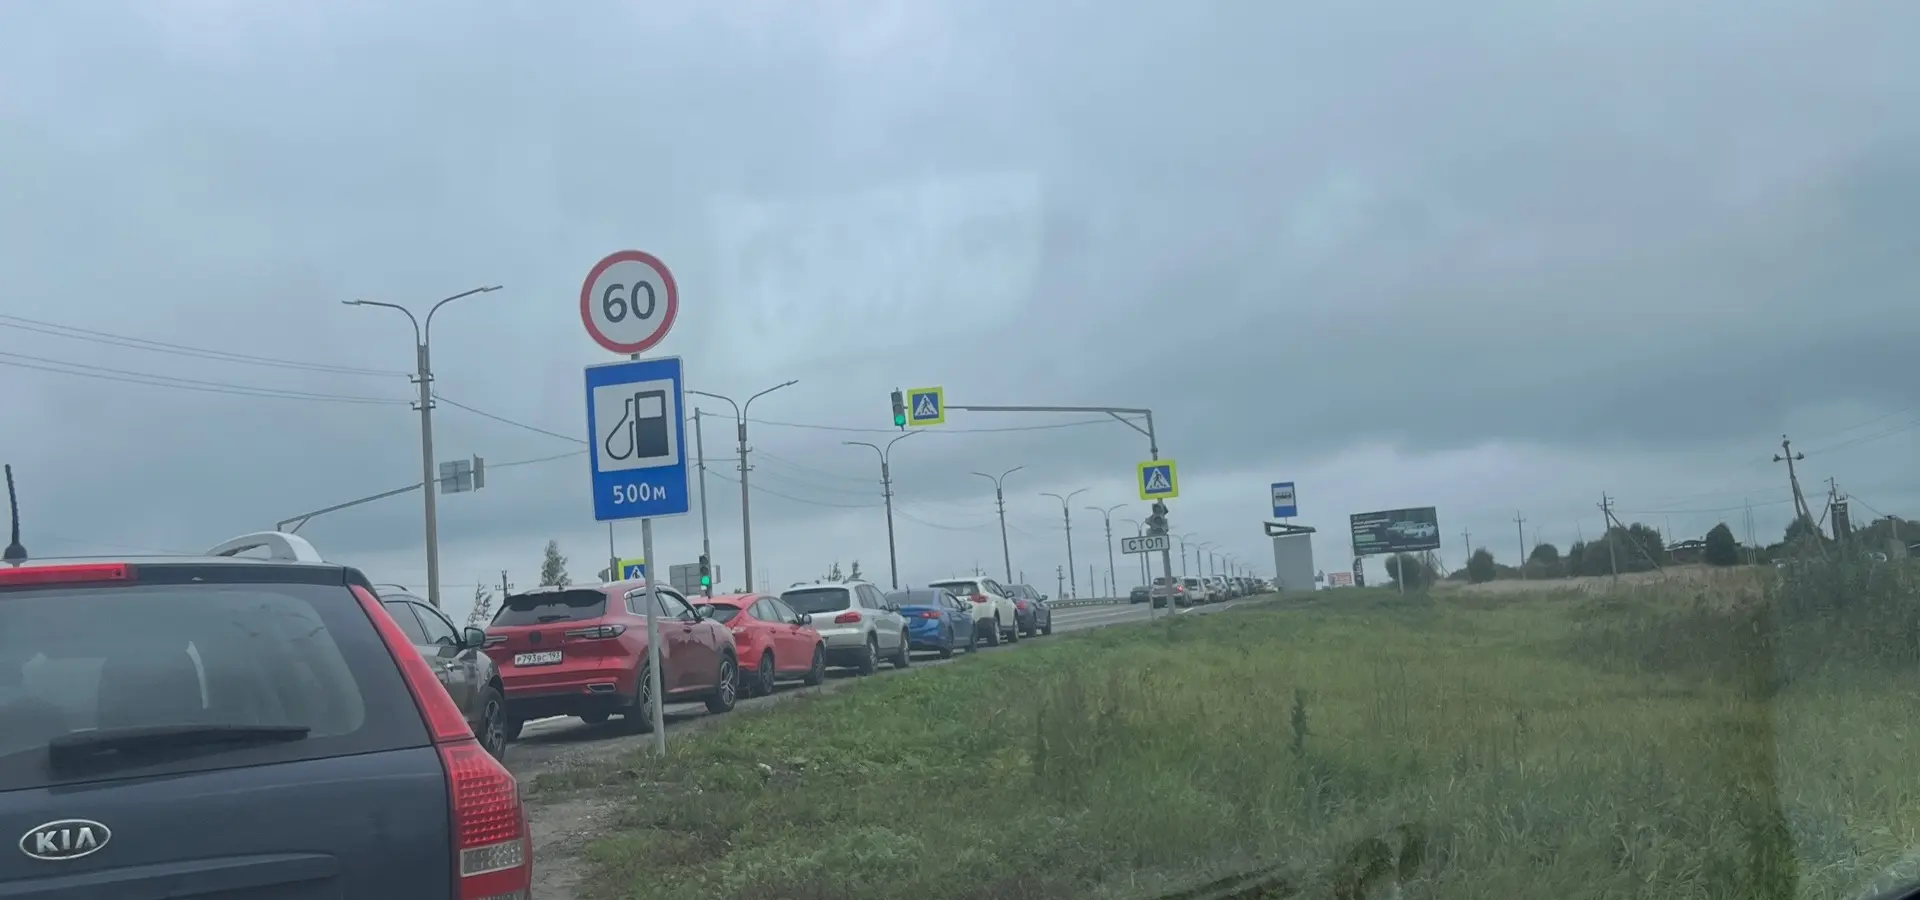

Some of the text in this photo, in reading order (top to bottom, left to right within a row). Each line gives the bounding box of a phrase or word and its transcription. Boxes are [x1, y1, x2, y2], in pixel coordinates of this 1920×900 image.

[603, 281, 656, 323] 60
[1128, 537, 1164, 551] СТОП
[35, 826, 98, 854] KIA
